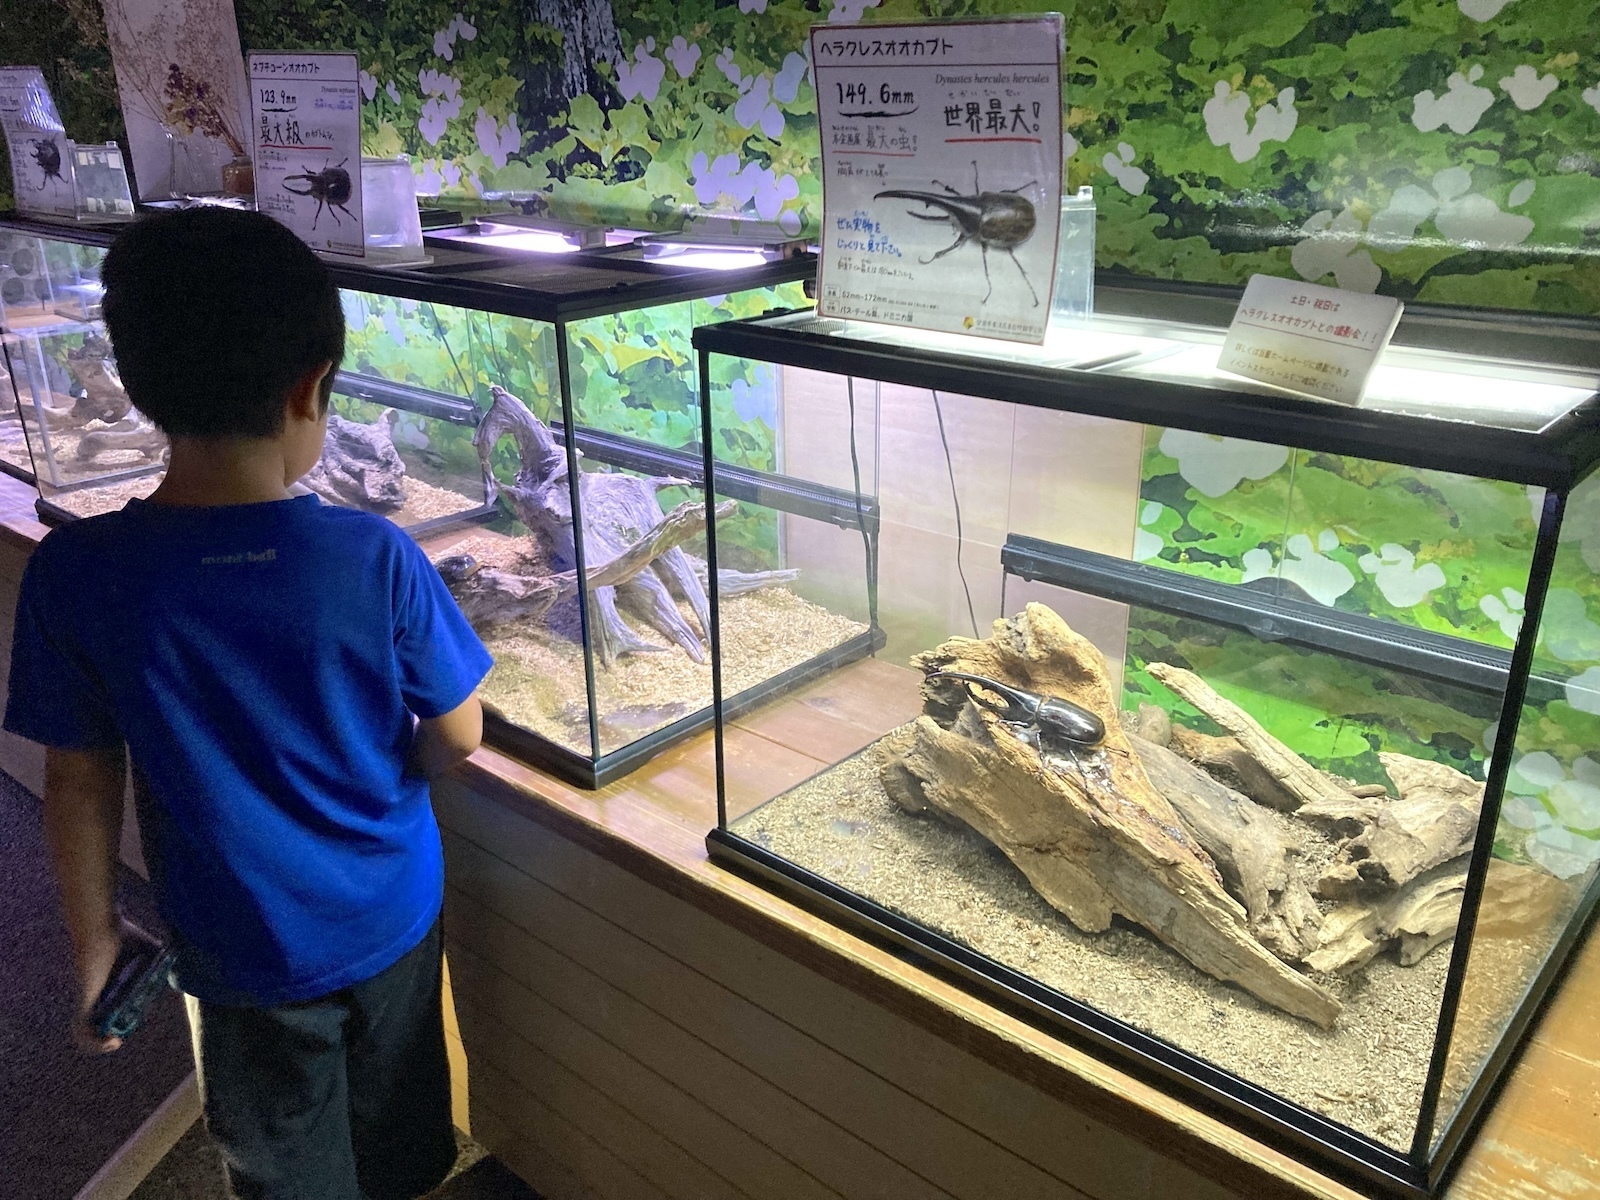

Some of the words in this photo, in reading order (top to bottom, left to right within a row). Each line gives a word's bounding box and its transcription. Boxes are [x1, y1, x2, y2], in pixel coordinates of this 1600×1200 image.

[820, 37, 953, 57] ヘラクレスオオカブト
[935, 73, 973, 86] Dynastes
[974, 73, 1010, 84] hercules
[1012, 72, 1050, 84] hercules
[1290, 295, 1341, 312] 土日・祝日は
